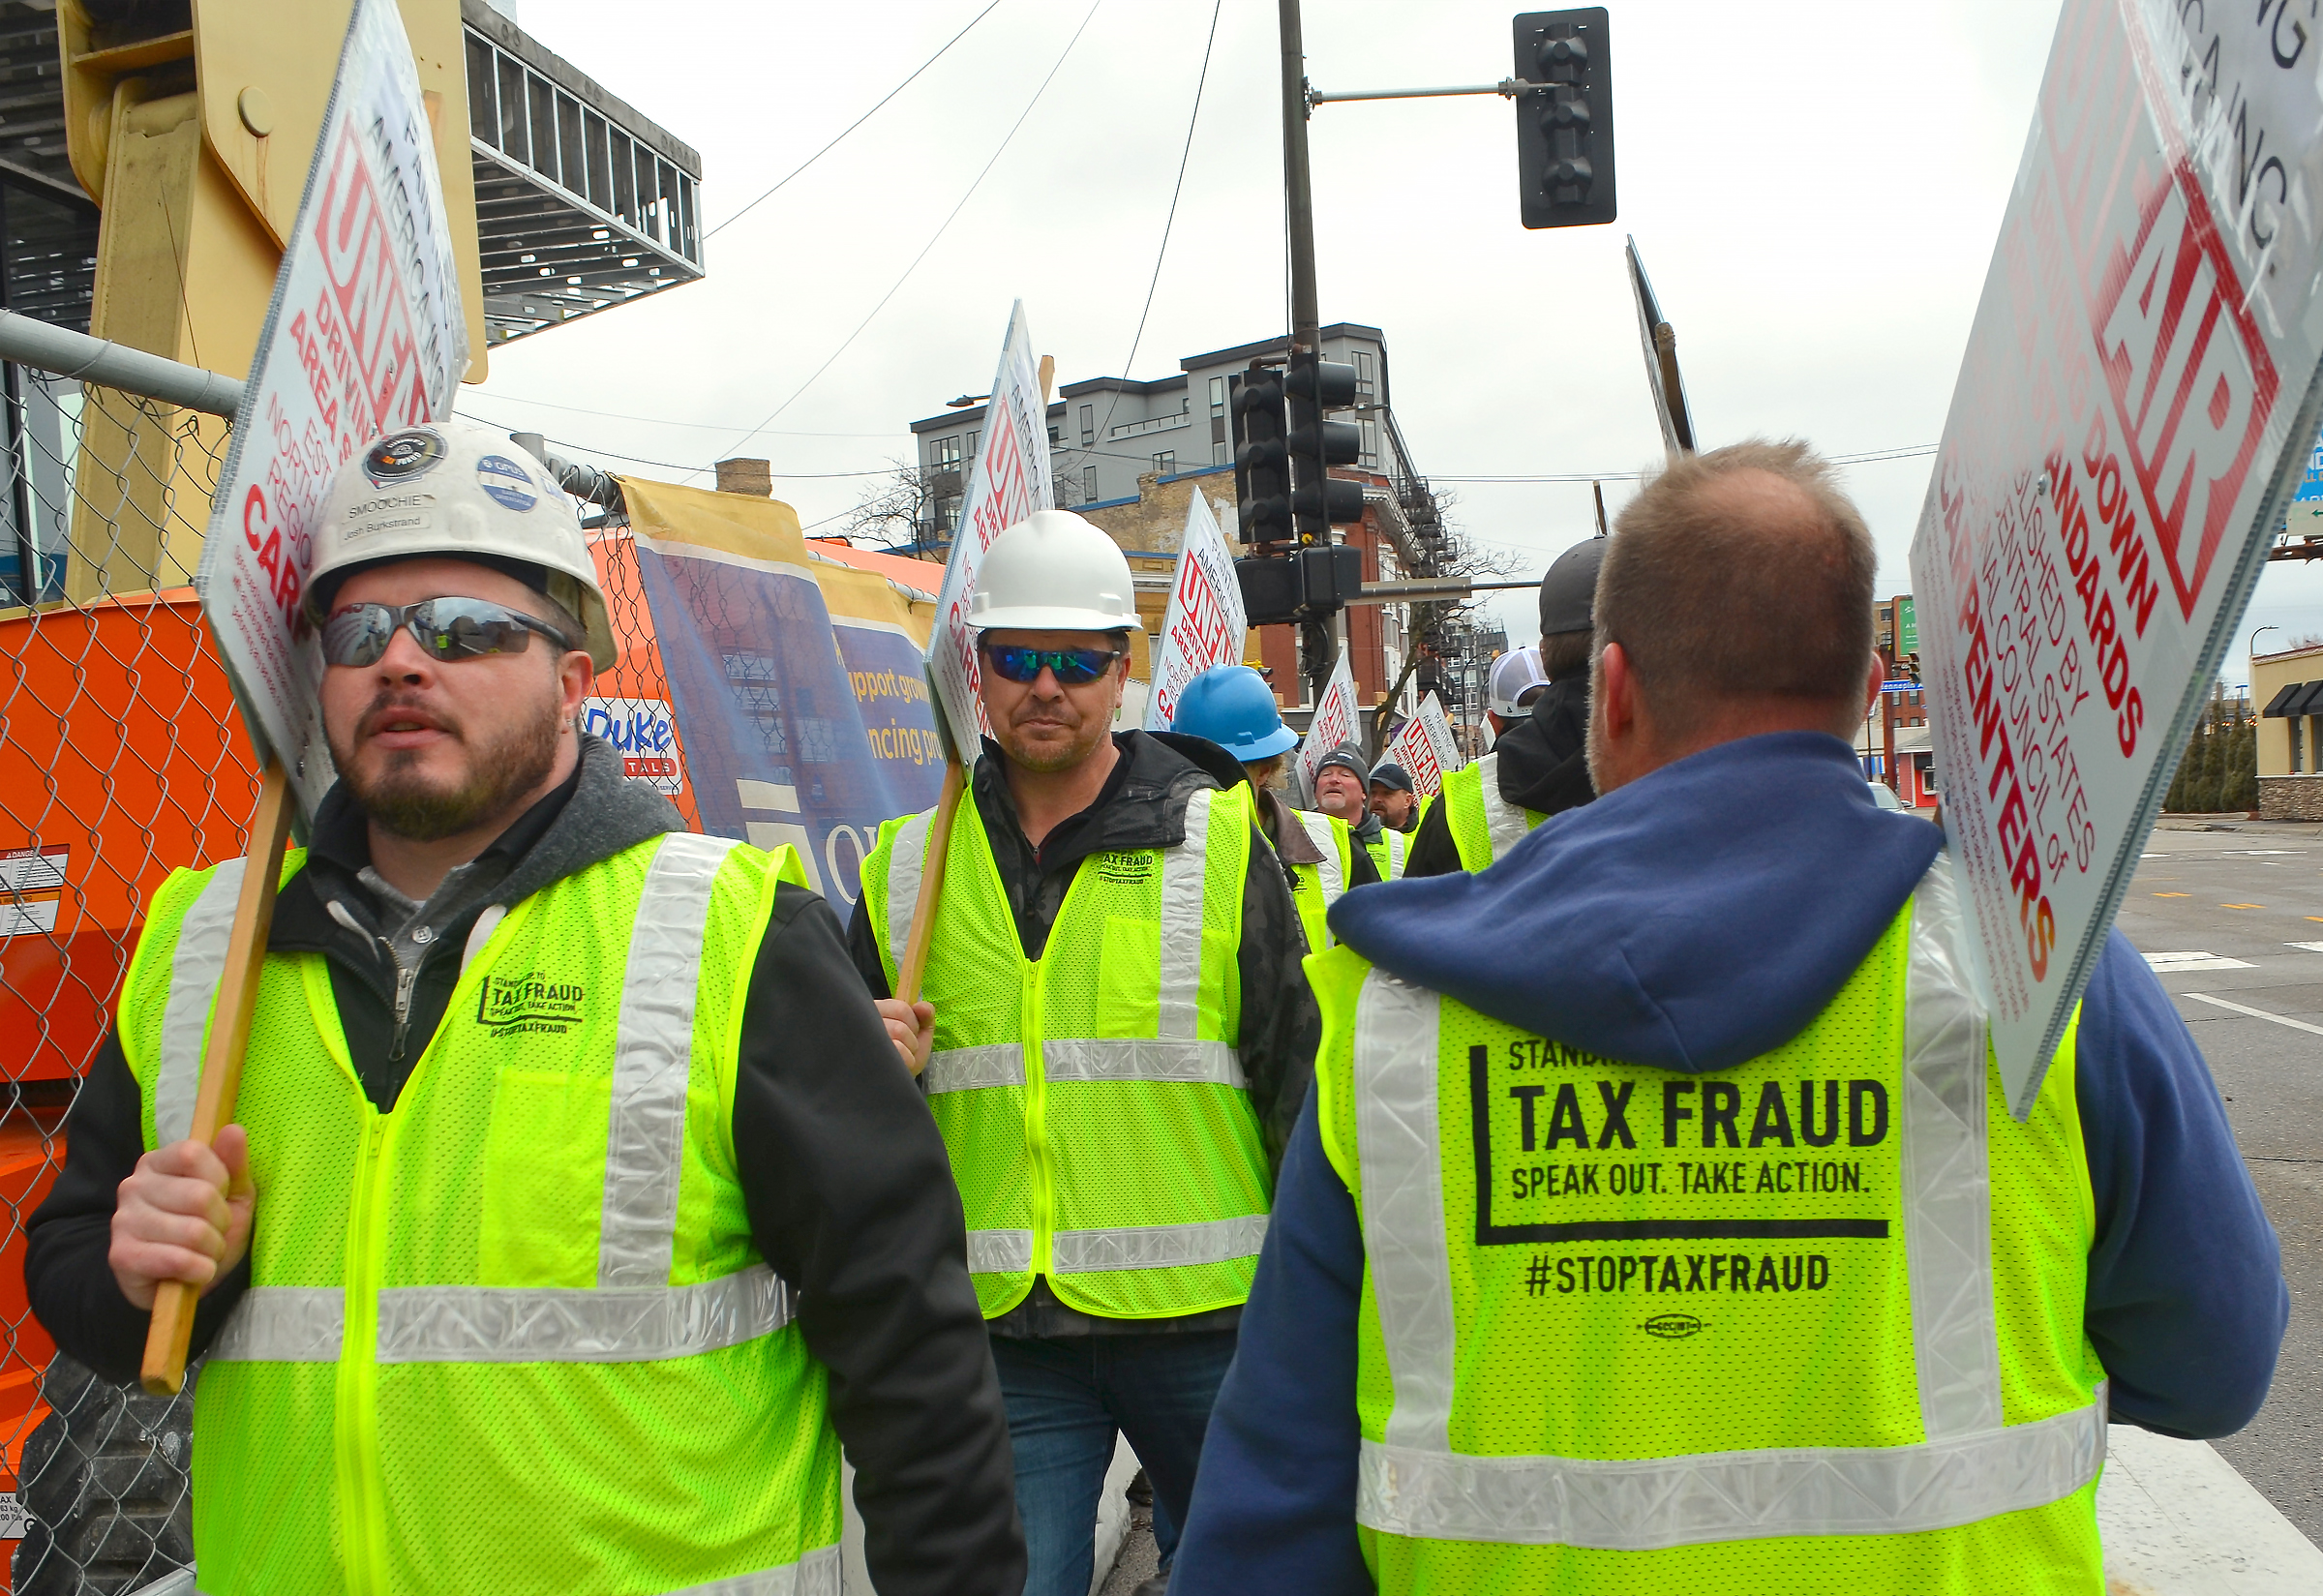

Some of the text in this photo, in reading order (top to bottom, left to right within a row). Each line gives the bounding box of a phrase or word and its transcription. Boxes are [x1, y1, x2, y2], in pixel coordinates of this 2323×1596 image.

[290, 308, 338, 446] AREA
[317, 286, 376, 446] DRIVIN
[268, 391, 317, 523] NORTH
[268, 456, 312, 570] REGIO
[344, 516, 420, 540] Josh Burkstrand
[348, 495, 421, 519] SMOOCHIE
[2082, 403, 2159, 640] DOWN
[1197, 548, 1230, 625] AMERICA
[1171, 624, 1193, 671] AREA
[2059, 637, 2090, 715] BY
[587, 708, 672, 752] Duke
[1423, 714, 1442, 753] AMERICA
[1940, 437, 2056, 984] CARPENTERS
[627, 761, 671, 773] TALS
[1405, 720, 1441, 798] UNFAIR
[1996, 614, 2050, 838] COUNCIL
[2046, 832, 2068, 885] of
[2037, 673, 2095, 874] STATES
[1120, 855, 1153, 866] FRAUD
[524, 982, 583, 1002] FRAUD
[1510, 1079, 1888, 1152] TAX FRAUD
[1513, 1161, 1870, 1199] SPEAK OUT. TAKE ACTION.
[1524, 1254, 1829, 1296] #STOPTAXFRAUD
